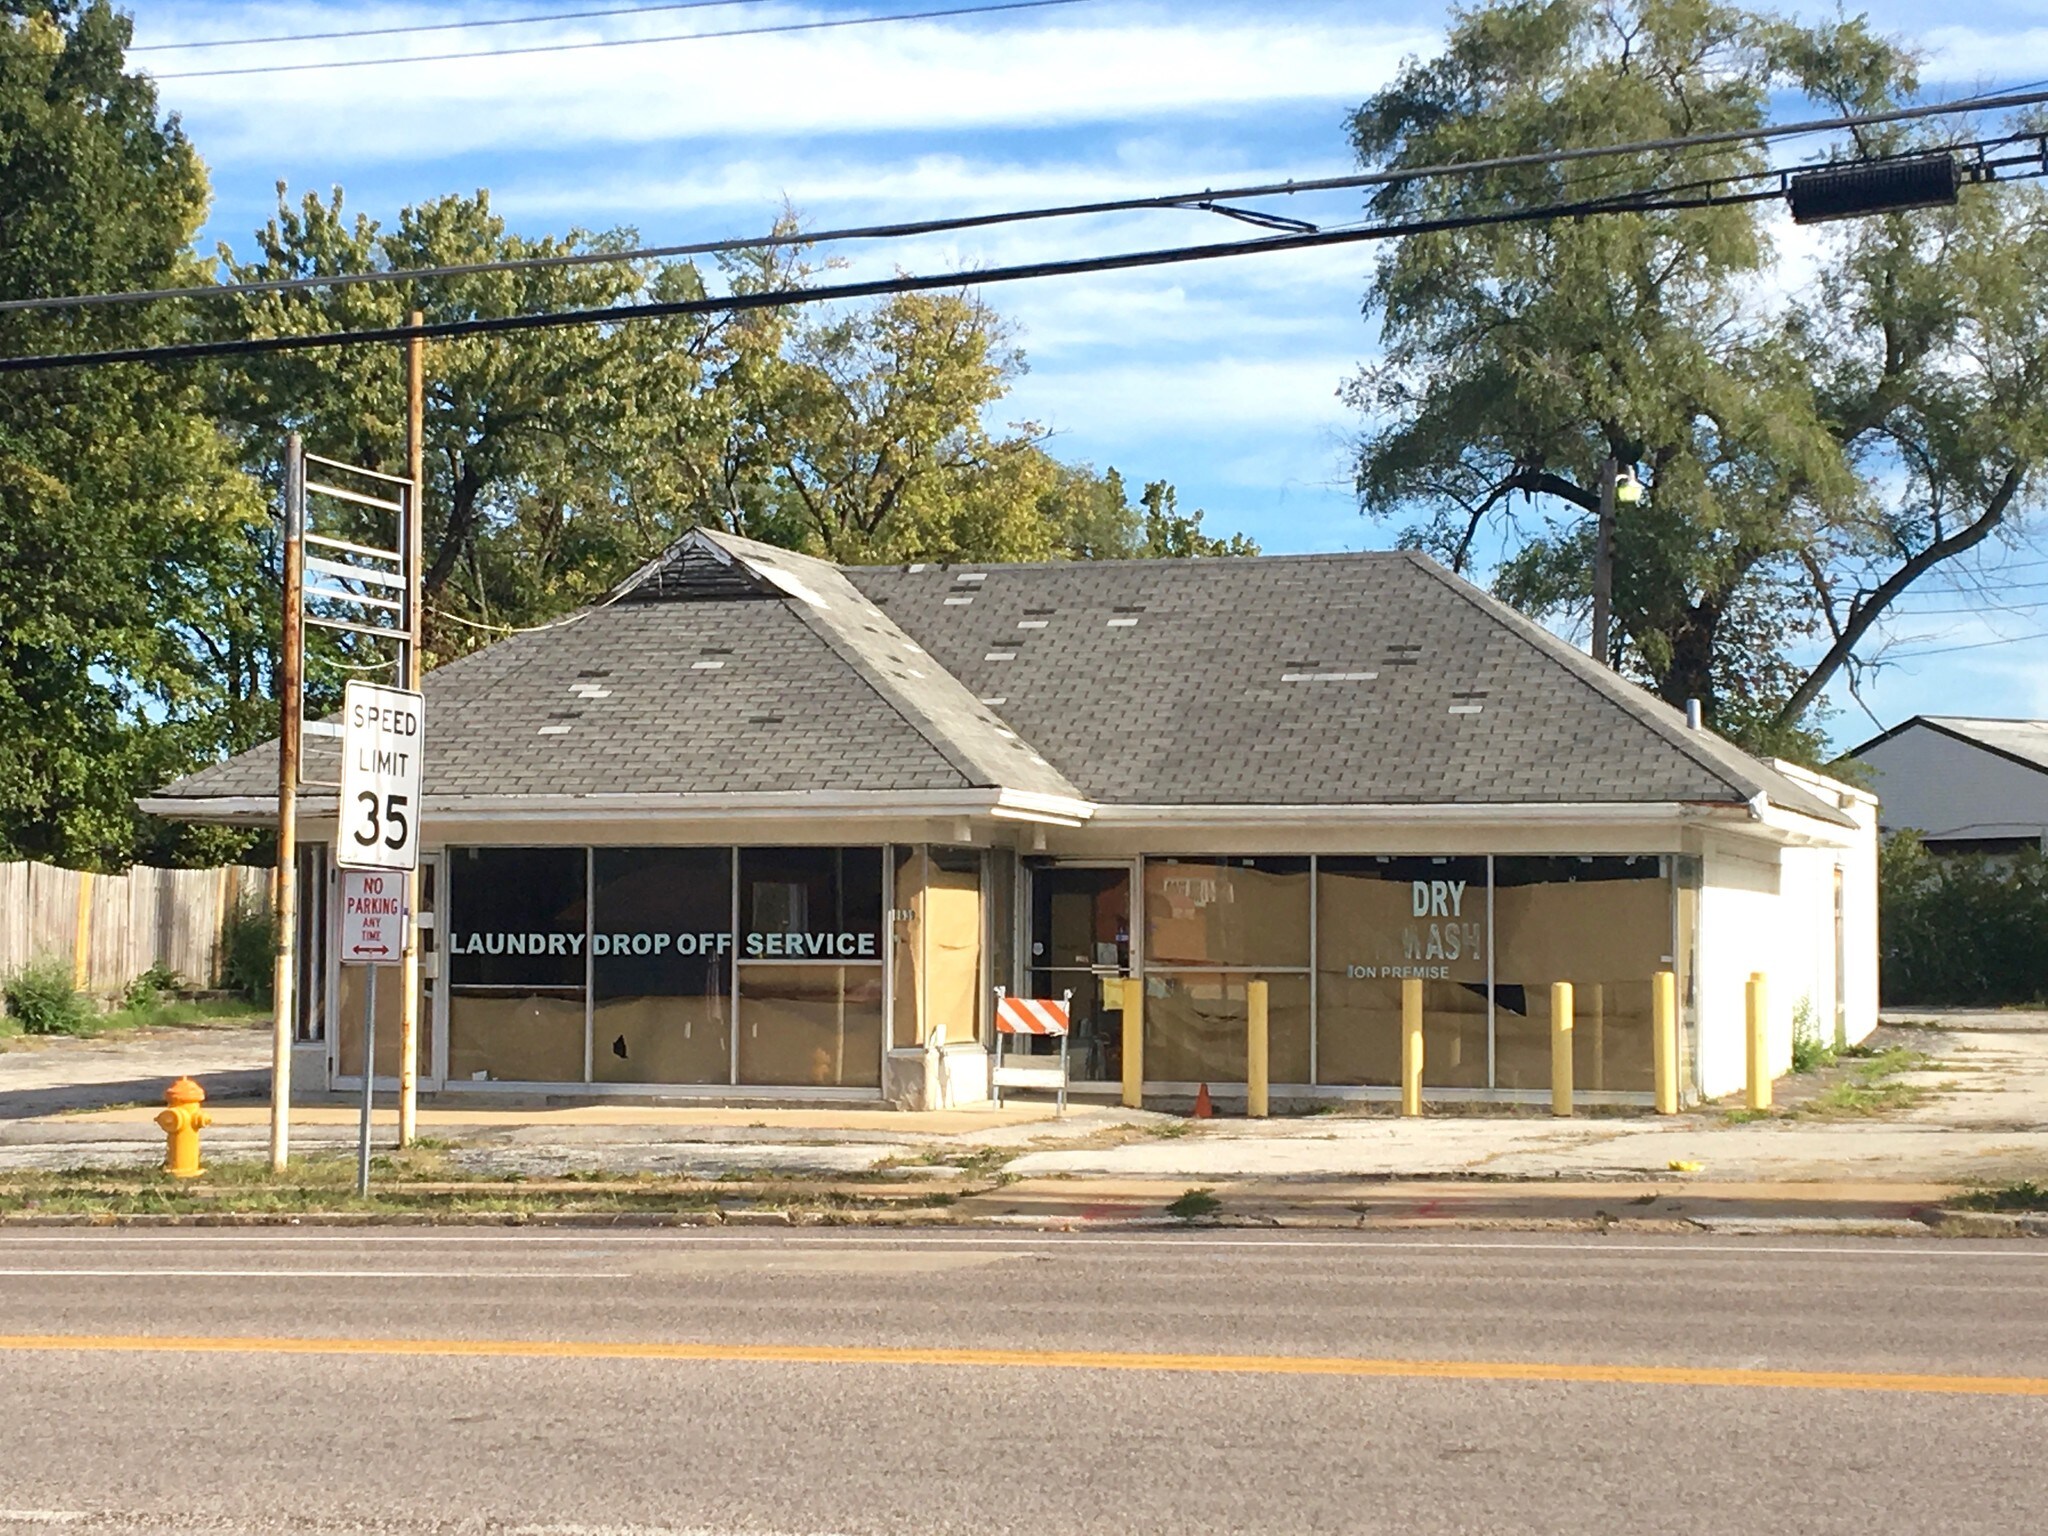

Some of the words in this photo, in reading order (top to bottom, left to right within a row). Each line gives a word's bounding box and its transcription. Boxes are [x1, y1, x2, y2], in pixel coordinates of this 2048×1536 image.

[354, 704, 417, 737] SPEED
[359, 748, 409, 777] LIMIT
[353, 790, 408, 850] 35
[363, 877, 383, 895] NO
[347, 897, 398, 915] PARKING
[1413, 880, 1466, 917] DRY
[362, 917, 381, 928] ANY
[362, 930, 381, 941] TIME
[450, 933, 586, 955] LAUNDRY
[593, 933, 671, 956] DROP
[677, 933, 732, 955] OFF
[746, 933, 875, 955] SERVICE
[1381, 966, 1450, 980] PREMISE
